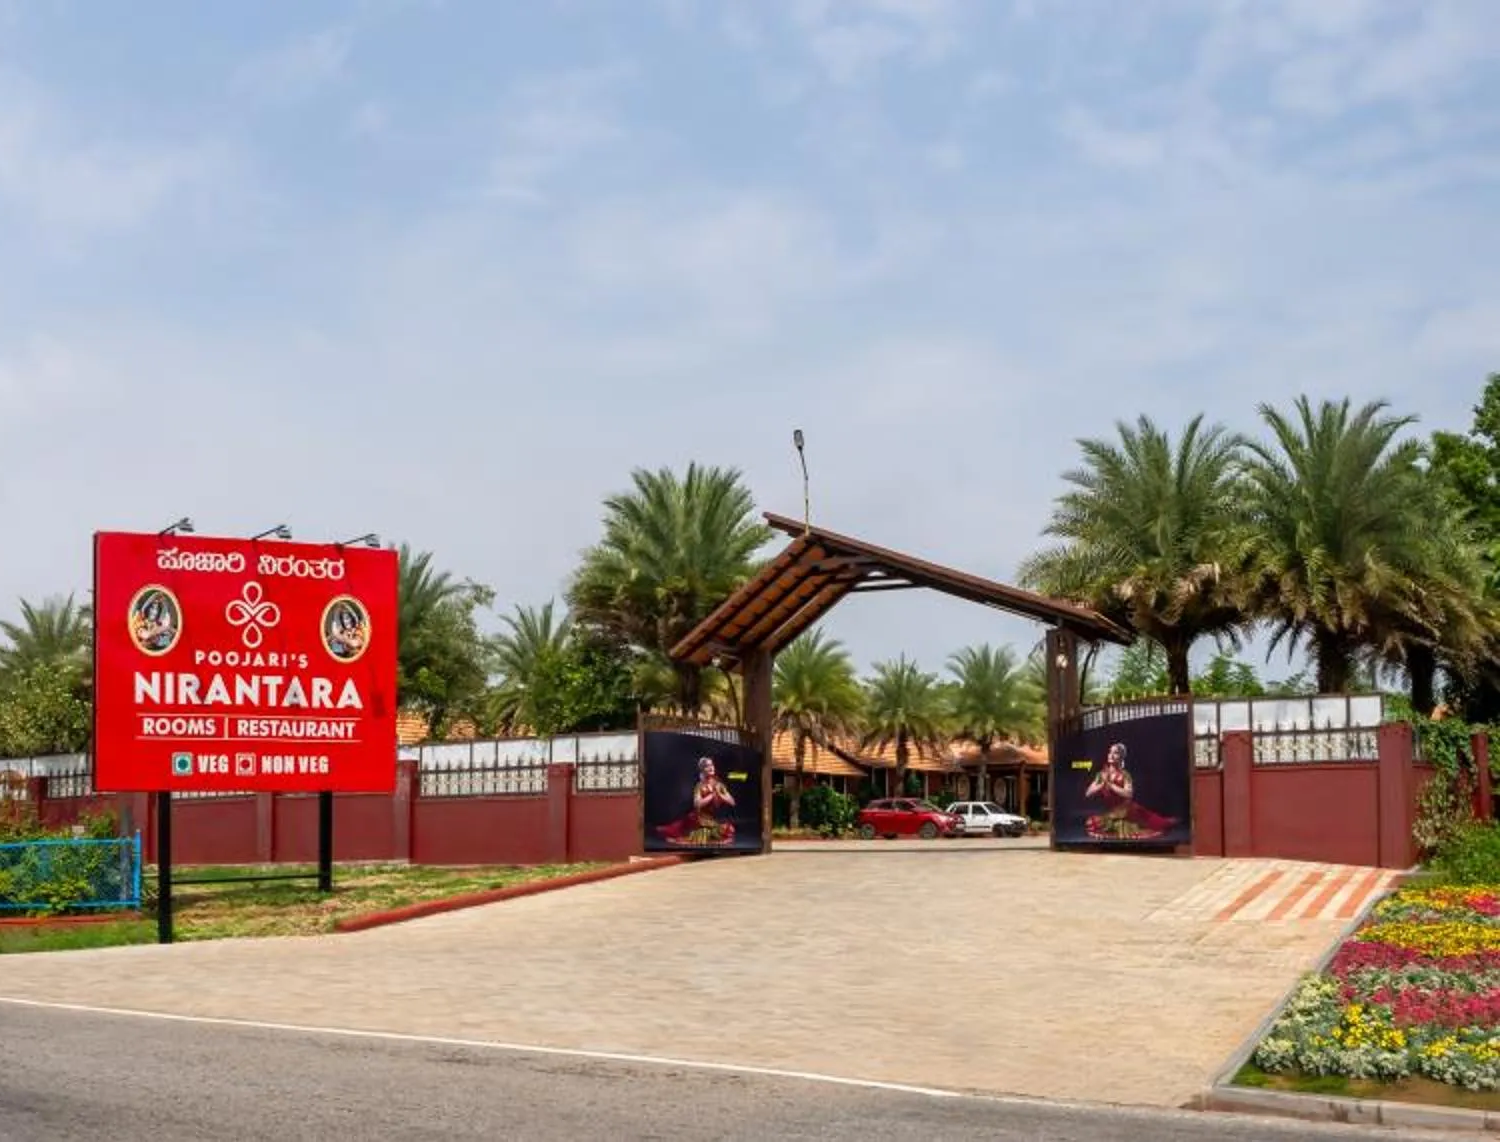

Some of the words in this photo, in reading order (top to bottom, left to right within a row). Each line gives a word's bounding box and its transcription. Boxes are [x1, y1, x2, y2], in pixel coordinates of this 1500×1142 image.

[156, 547, 245, 573] ಪೂಜಾರಿ
[257, 554, 345, 580] ನಿರಂತರ
[195, 650, 309, 669] POOJARI'S
[134, 671, 364, 709] NIRANTARA
[143, 717, 216, 736] ROOMS
[237, 719, 356, 739] RESTAURANT
[197, 755, 229, 774] VEG
[261, 755, 295, 774] NON
[298, 756, 329, 774] VEG
